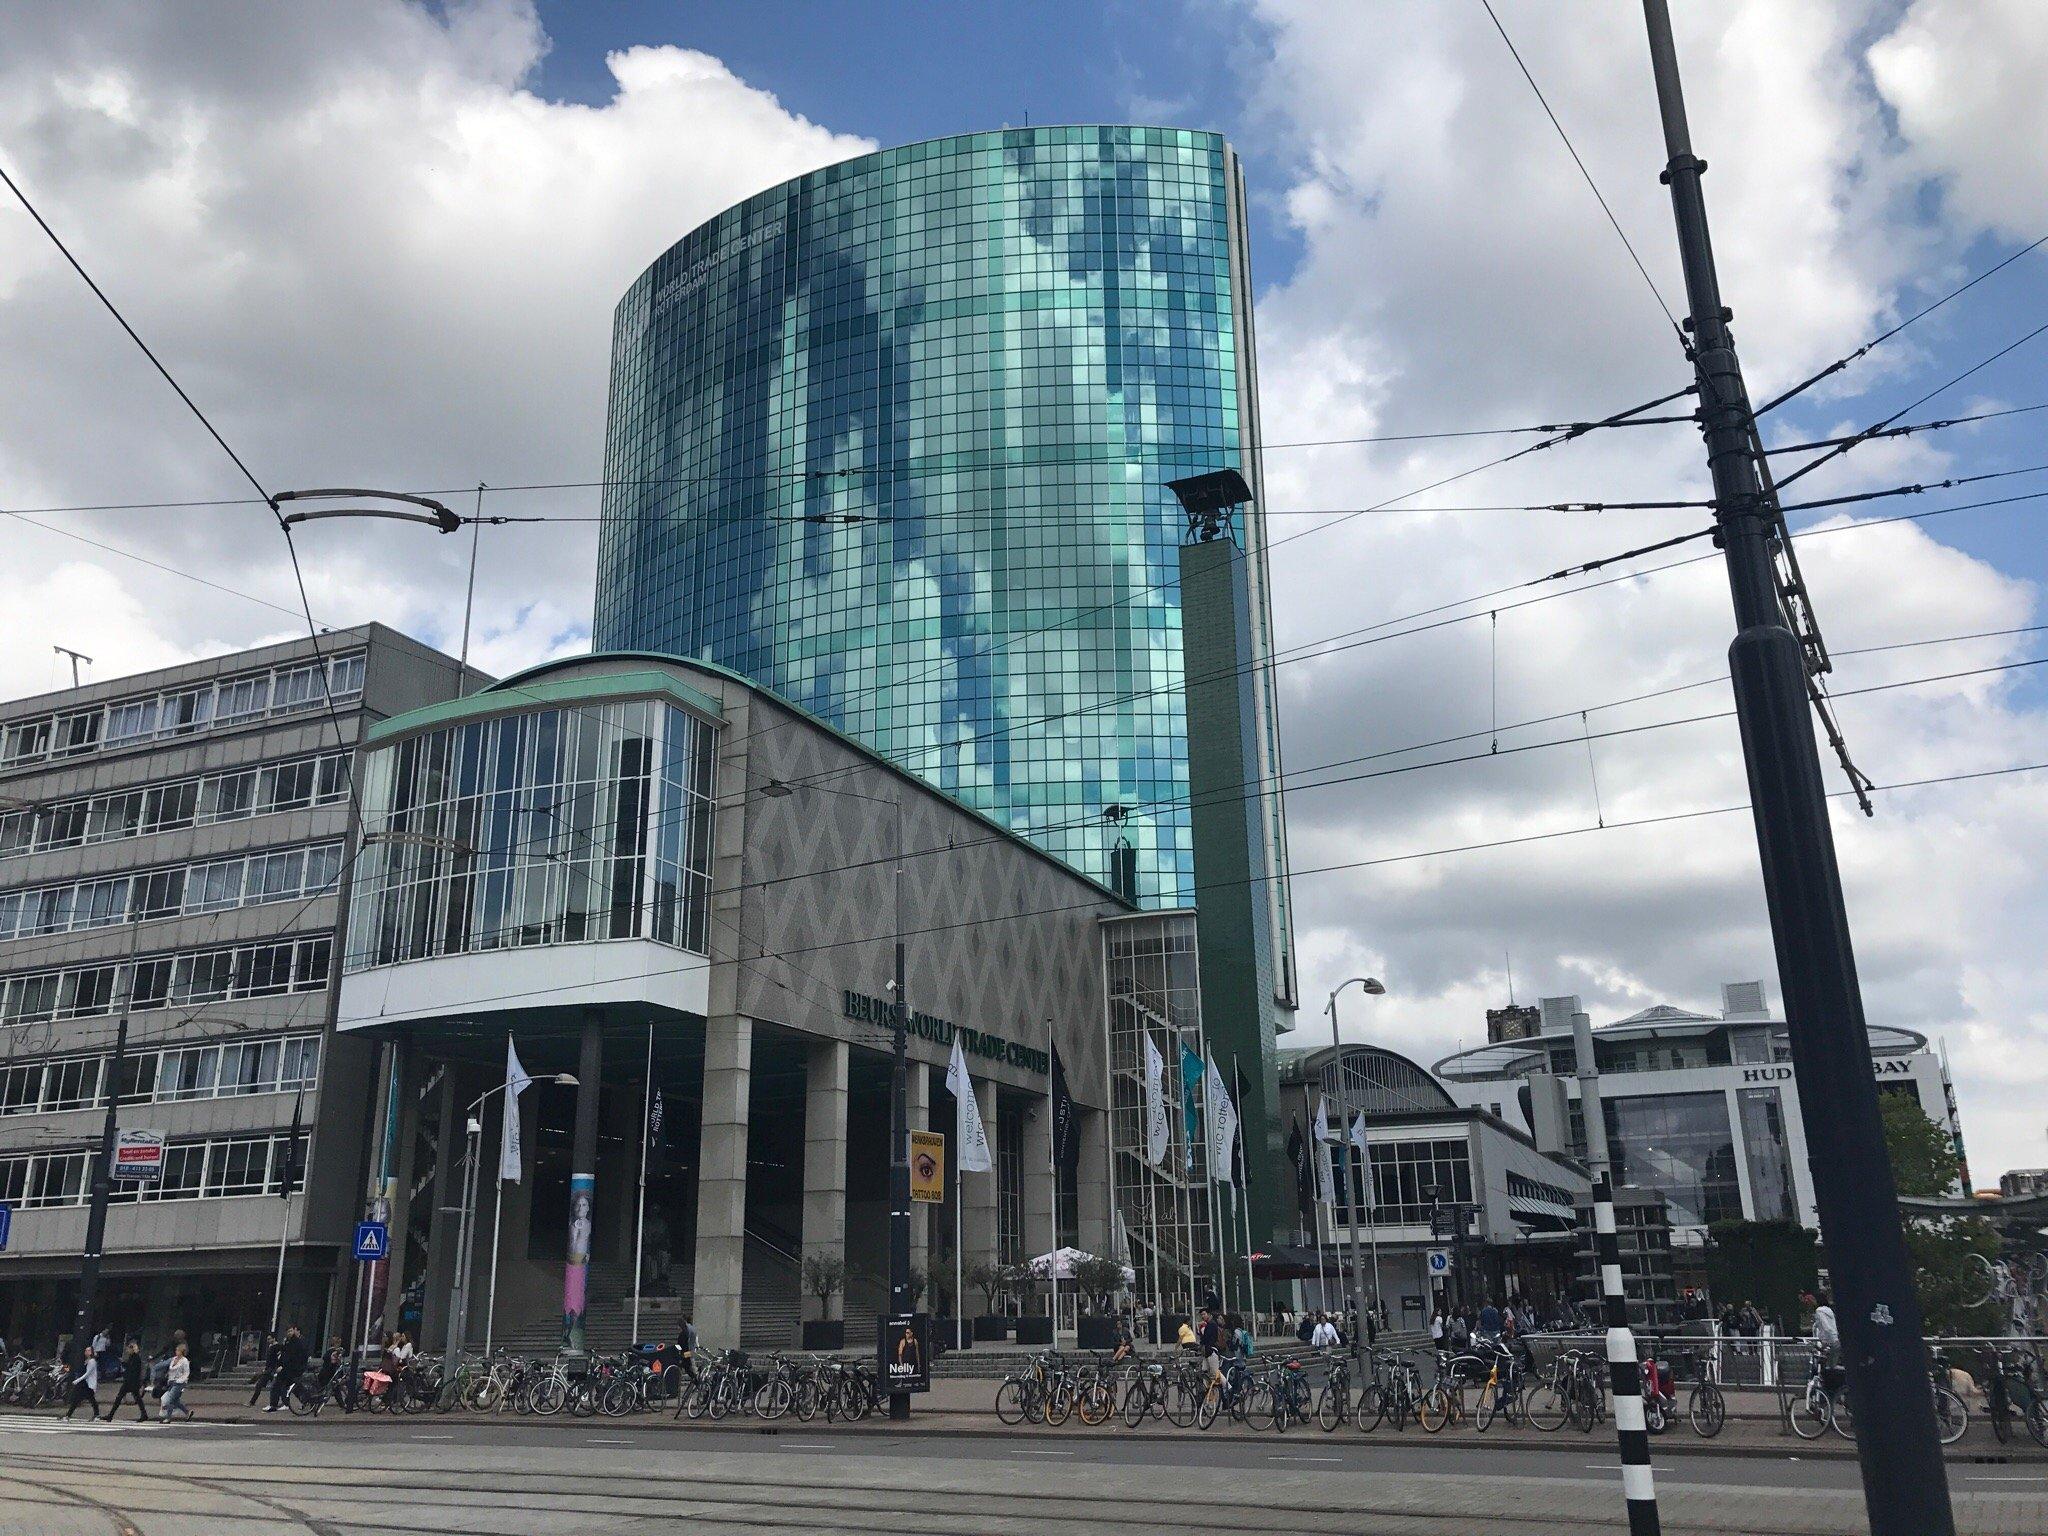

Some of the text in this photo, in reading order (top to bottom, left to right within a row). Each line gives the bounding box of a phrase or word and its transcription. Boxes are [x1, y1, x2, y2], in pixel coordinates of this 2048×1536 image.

[655, 222, 782, 303] WORLD TRADE CENTER
[654, 273, 707, 317] ROTTERDAM
[960, 1026, 1006, 1063] TRADE
[1006, 1041, 1048, 1076] CENTER
[1743, 1067, 1792, 1082] HUD
[912, 1189, 930, 1199] TATTOO
[889, 1363, 915, 1375] Nelly
